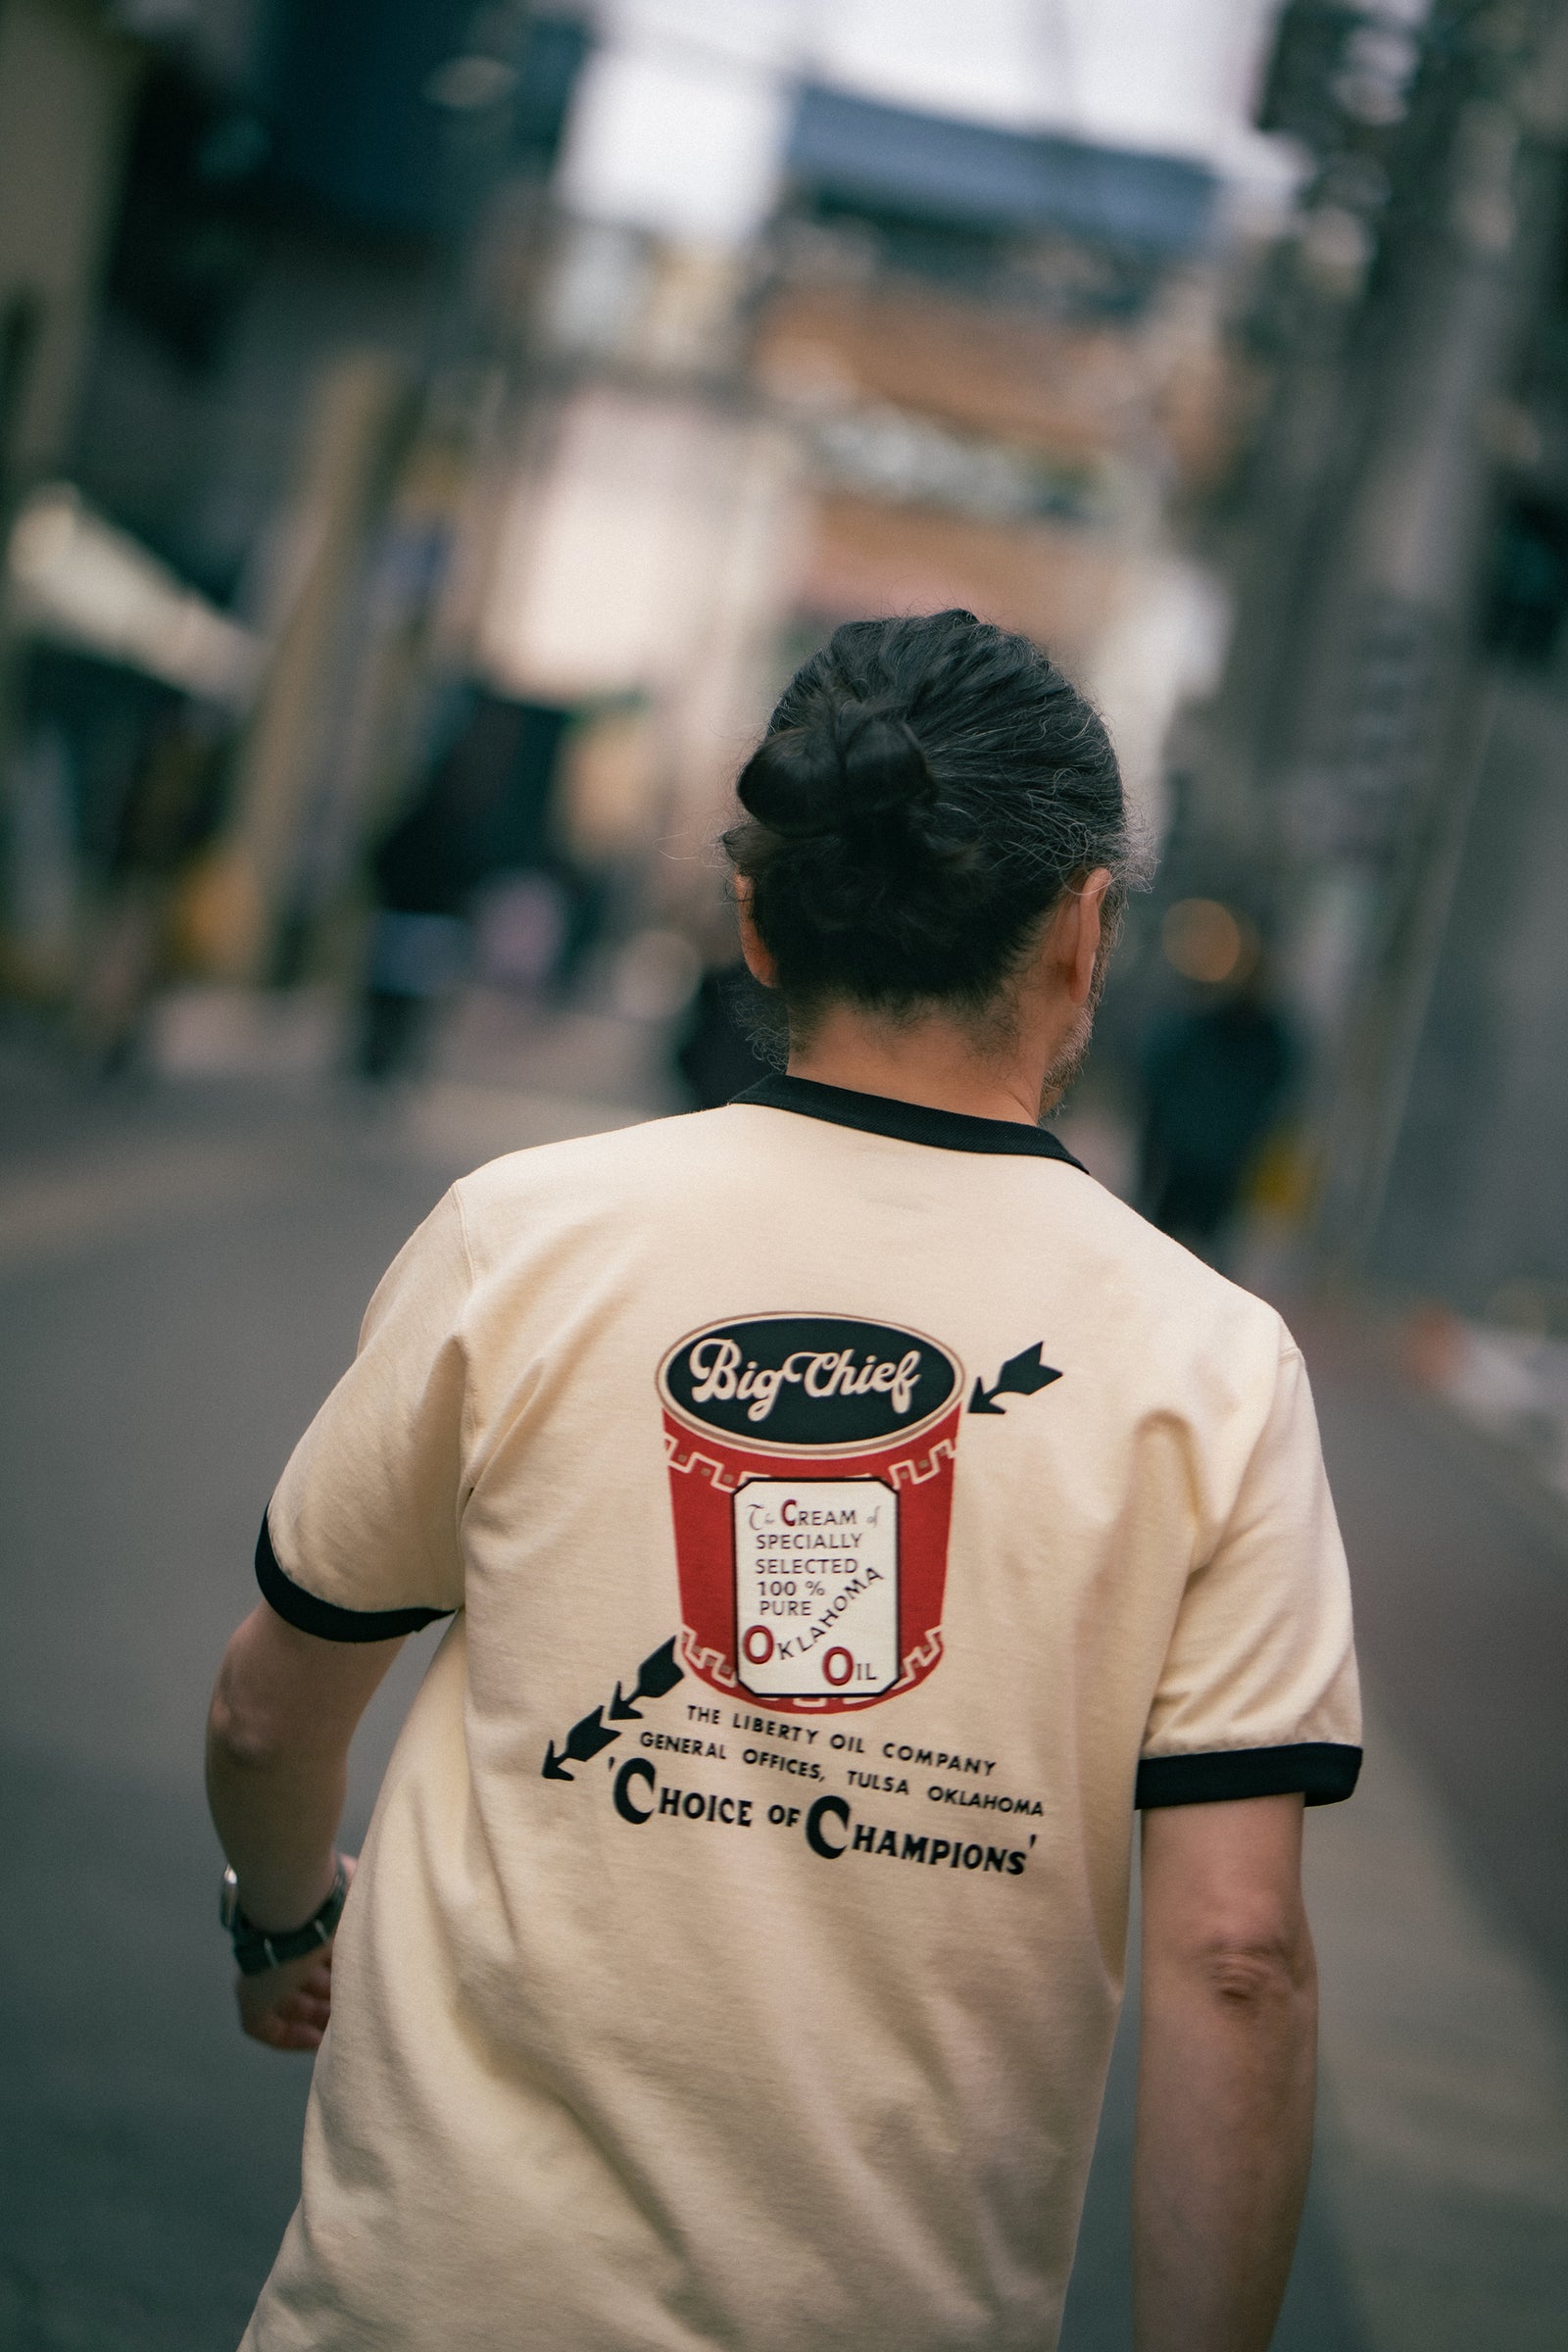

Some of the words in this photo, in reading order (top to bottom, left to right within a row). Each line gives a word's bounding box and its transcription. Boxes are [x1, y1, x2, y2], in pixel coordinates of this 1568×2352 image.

[689, 1338, 787, 1422] Big
[783, 1348, 922, 1414] Chief
[780, 1498, 858, 1527] CREAM
[756, 1533, 863, 1550] SPECIALLY
[756, 1558, 859, 1575] SELECTED
[757, 1581, 798, 1597] 100
[805, 1580, 826, 1597] %
[742, 1566, 885, 1666] OKLAHOMA
[760, 1600, 813, 1617] PURE
[821, 1645, 878, 1687] OIL
[687, 1704, 720, 1726] THE
[732, 1712, 819, 1745] LIBERTY
[829, 1733, 865, 1754] OIL
[882, 1741, 997, 1777] COMPANY
[639, 1731, 727, 1760] GENERAL
[742, 1748, 826, 1783] OFFICES,
[847, 1770, 909, 1796] TULSA
[927, 1786, 1045, 1817] OKLAHOMA
[766, 1803, 802, 1828] OF
